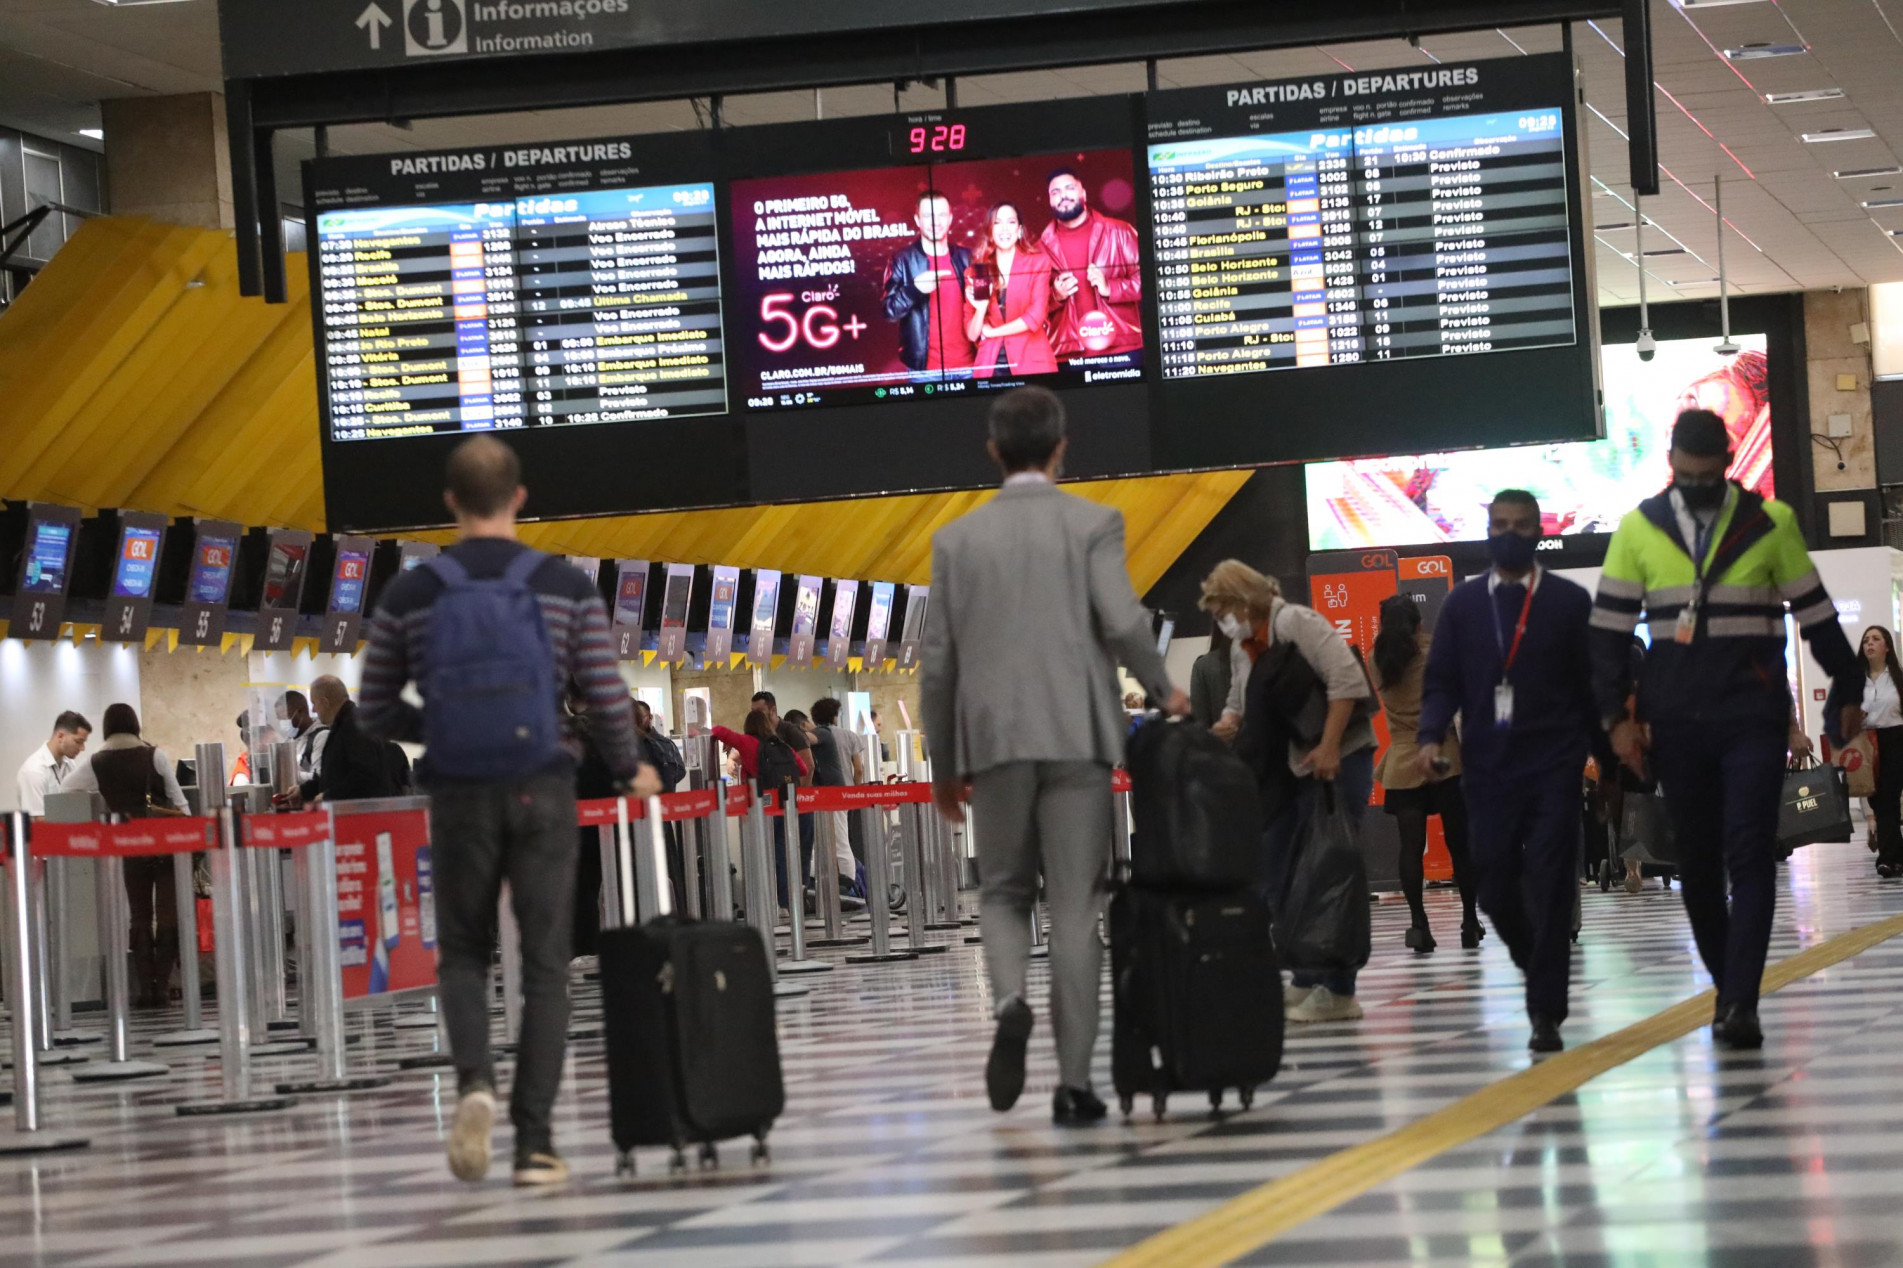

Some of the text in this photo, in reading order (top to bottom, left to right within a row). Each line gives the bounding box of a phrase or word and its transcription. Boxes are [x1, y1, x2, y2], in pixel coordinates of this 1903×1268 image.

[474, 0, 629, 22] Informações
[476, 30, 593, 52] Information
[1227, 83, 1325, 107] PARTIDAS
[1343, 68, 1478, 96] DEPARTURES
[1148, 122, 1172, 131] previsto
[1178, 119, 1200, 127] destino
[1320, 106, 1348, 114] empresa
[1377, 102, 1397, 110] portão
[1399, 99, 1434, 108] confirmado
[1442, 93, 1483, 103] observações
[1148, 130, 1176, 138] schedule
[1178, 126, 1212, 135] destination
[1377, 110, 1391, 119] gate
[1400, 107, 1431, 116] confirmed
[1443, 103, 1469, 112] remarks
[1310, 127, 1418, 149] Partidas
[391, 154, 486, 176] PARTIDAS
[504, 143, 632, 167] DEPARTURES
[1152, 145, 1500, 185] 10:30 Ribeirão Preto 21 Confirmado
[1186, 161, 1480, 195] Porto Seguro 3002 Previsto
[1187, 174, 1481, 208] Goiânia 3102 Previsto
[474, 198, 578, 218] Partidas
[754, 201, 764, 215] O
[765, 197, 828, 214] PRIMEIRO
[1154, 187, 1482, 223] 10:40 RJ 2136 17 Previsto
[755, 205, 880, 231] A INTERNET MÓVEL
[1155, 200, 1482, 236] 10:40 RJ 07 Previsto
[756, 223, 915, 248] MAIS RÁPIDA DO BRASIL.
[1189, 213, 1483, 246] Florianópolis 12 Previsto
[1369, 234, 1383, 243] 07
[354, 236, 421, 249] Navegantes
[809, 245, 851, 260] AINDA
[759, 260, 855, 280] MAIS RÁPIDOS!
[1158, 251, 1352, 275] 10:50 Belo Horizonte 3042
[356, 274, 398, 286] Maceió
[1159, 261, 1386, 288] 10:50 Belo Horizonte 04
[1193, 273, 1386, 298] Goiânia 01
[396, 285, 442, 296] Dumont
[802, 291, 835, 302] Claro
[397, 298, 443, 308] Dumont
[532, 302, 546, 310] 12
[1161, 301, 1230, 313] 11:00 Recife
[1195, 311, 1236, 324] Cuiabá
[1195, 312, 1388, 337] Porto Alegre 11
[360, 329, 389, 338] Natal
[596, 331, 707, 347] Embarque Imediato
[1080, 326, 1109, 337] Claro
[1163, 328, 1357, 352] 11:10 RJ 1022
[398, 339, 429, 348] Preto
[401, 345, 656, 372] Dumont Embarque
[1165, 350, 1391, 377] 11:20 Navegantes 11
[1197, 348, 1270, 362] Porto Alegre
[402, 355, 708, 385] Dumont Embarque Imediato
[536, 370, 657, 388] 11 Embarque
[364, 401, 410, 413] Curitiba
[404, 412, 450, 422] Dumont
[366, 408, 668, 439] Navegantes 10 Confirmado
[131, 541, 147, 558] GOL
[208, 549, 222, 565] GOL
[345, 563, 358, 577] GOL
[1361, 554, 1394, 568] GOL
[1417, 560, 1447, 574] GOL
[30, 602, 46, 632] 53
[120, 606, 133, 634] 54
[196, 611, 210, 638] 55
[270, 618, 282, 643] 56
[335, 621, 347, 646] 57
[621, 632, 629, 654] 62
[884, 789, 908, 798] milhas
